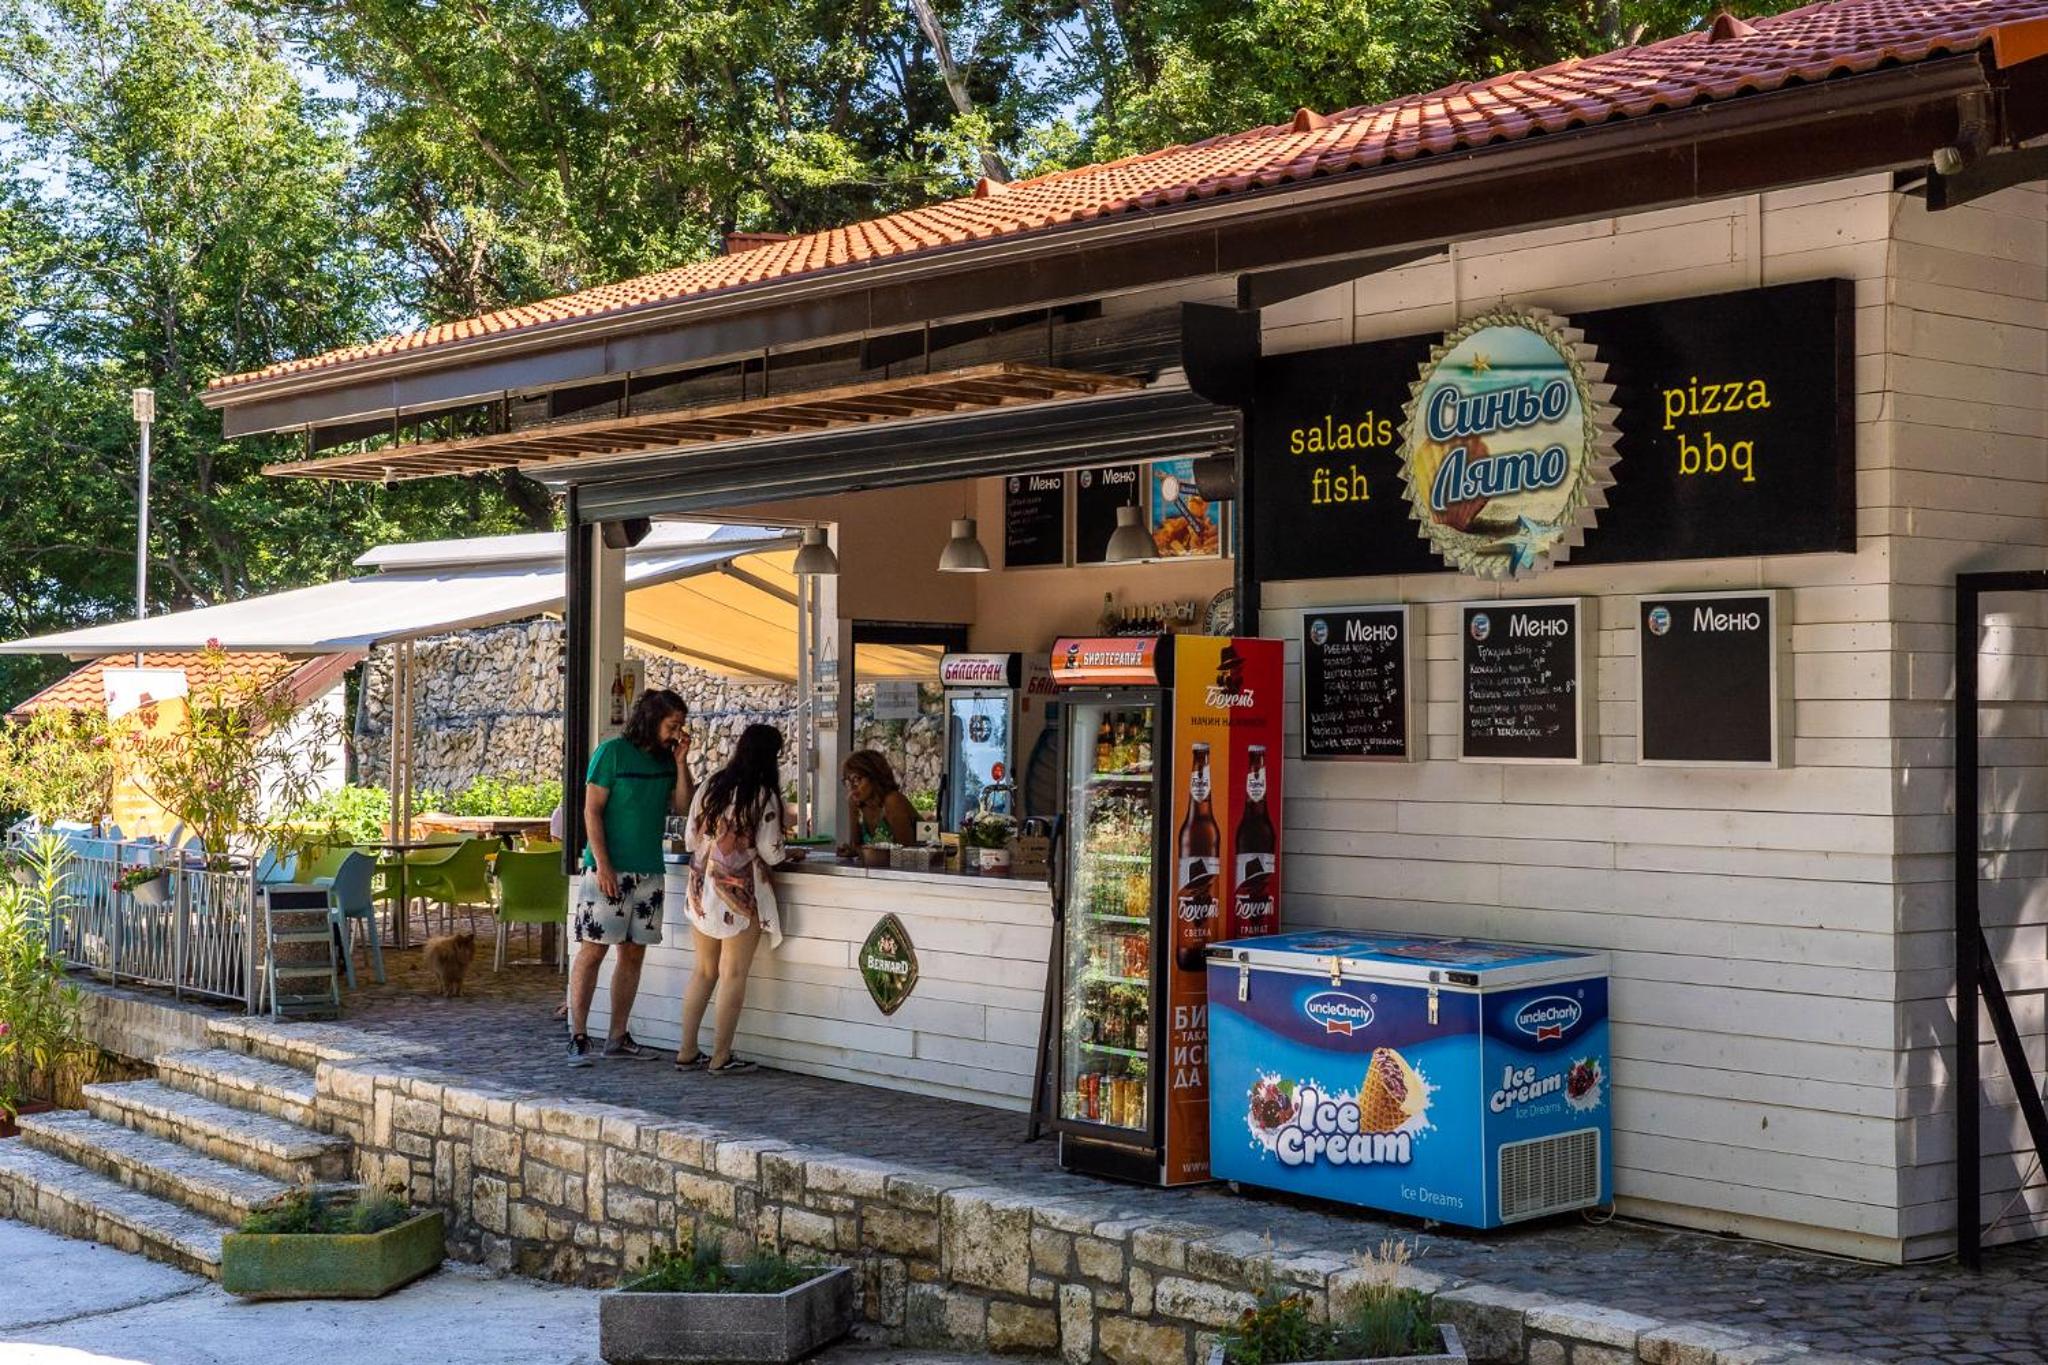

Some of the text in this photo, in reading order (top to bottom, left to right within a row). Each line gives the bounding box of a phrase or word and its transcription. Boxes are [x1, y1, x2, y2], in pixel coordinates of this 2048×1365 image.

[1428, 380, 1570, 442] Синьо
[1662, 376, 1771, 429] pizza
[1290, 411, 1393, 455] salads
[1678, 433, 1756, 483] bbq
[1029, 476, 1061, 491] Меню
[1102, 469, 1136, 486] Меню
[1311, 466, 1370, 505] fish
[1432, 446, 1565, 510] Лято
[1345, 619, 1398, 642] Меню
[1510, 614, 1568, 637] Меню
[1692, 606, 1761, 634] Меню
[1309, 1002, 1370, 1022] uncleCharly
[1520, 1004, 1578, 1025] uncleCharly
[1174, 1068, 1202, 1089] ДА
[1502, 1065, 1536, 1090] Ice
[1489, 1072, 1562, 1115] Cream
[1296, 1087, 1362, 1134] Ice
[1515, 1102, 1562, 1120] Ice Dreams
[1276, 1129, 1412, 1166] Cream
[1401, 1184, 1464, 1210] Ice Dreams
